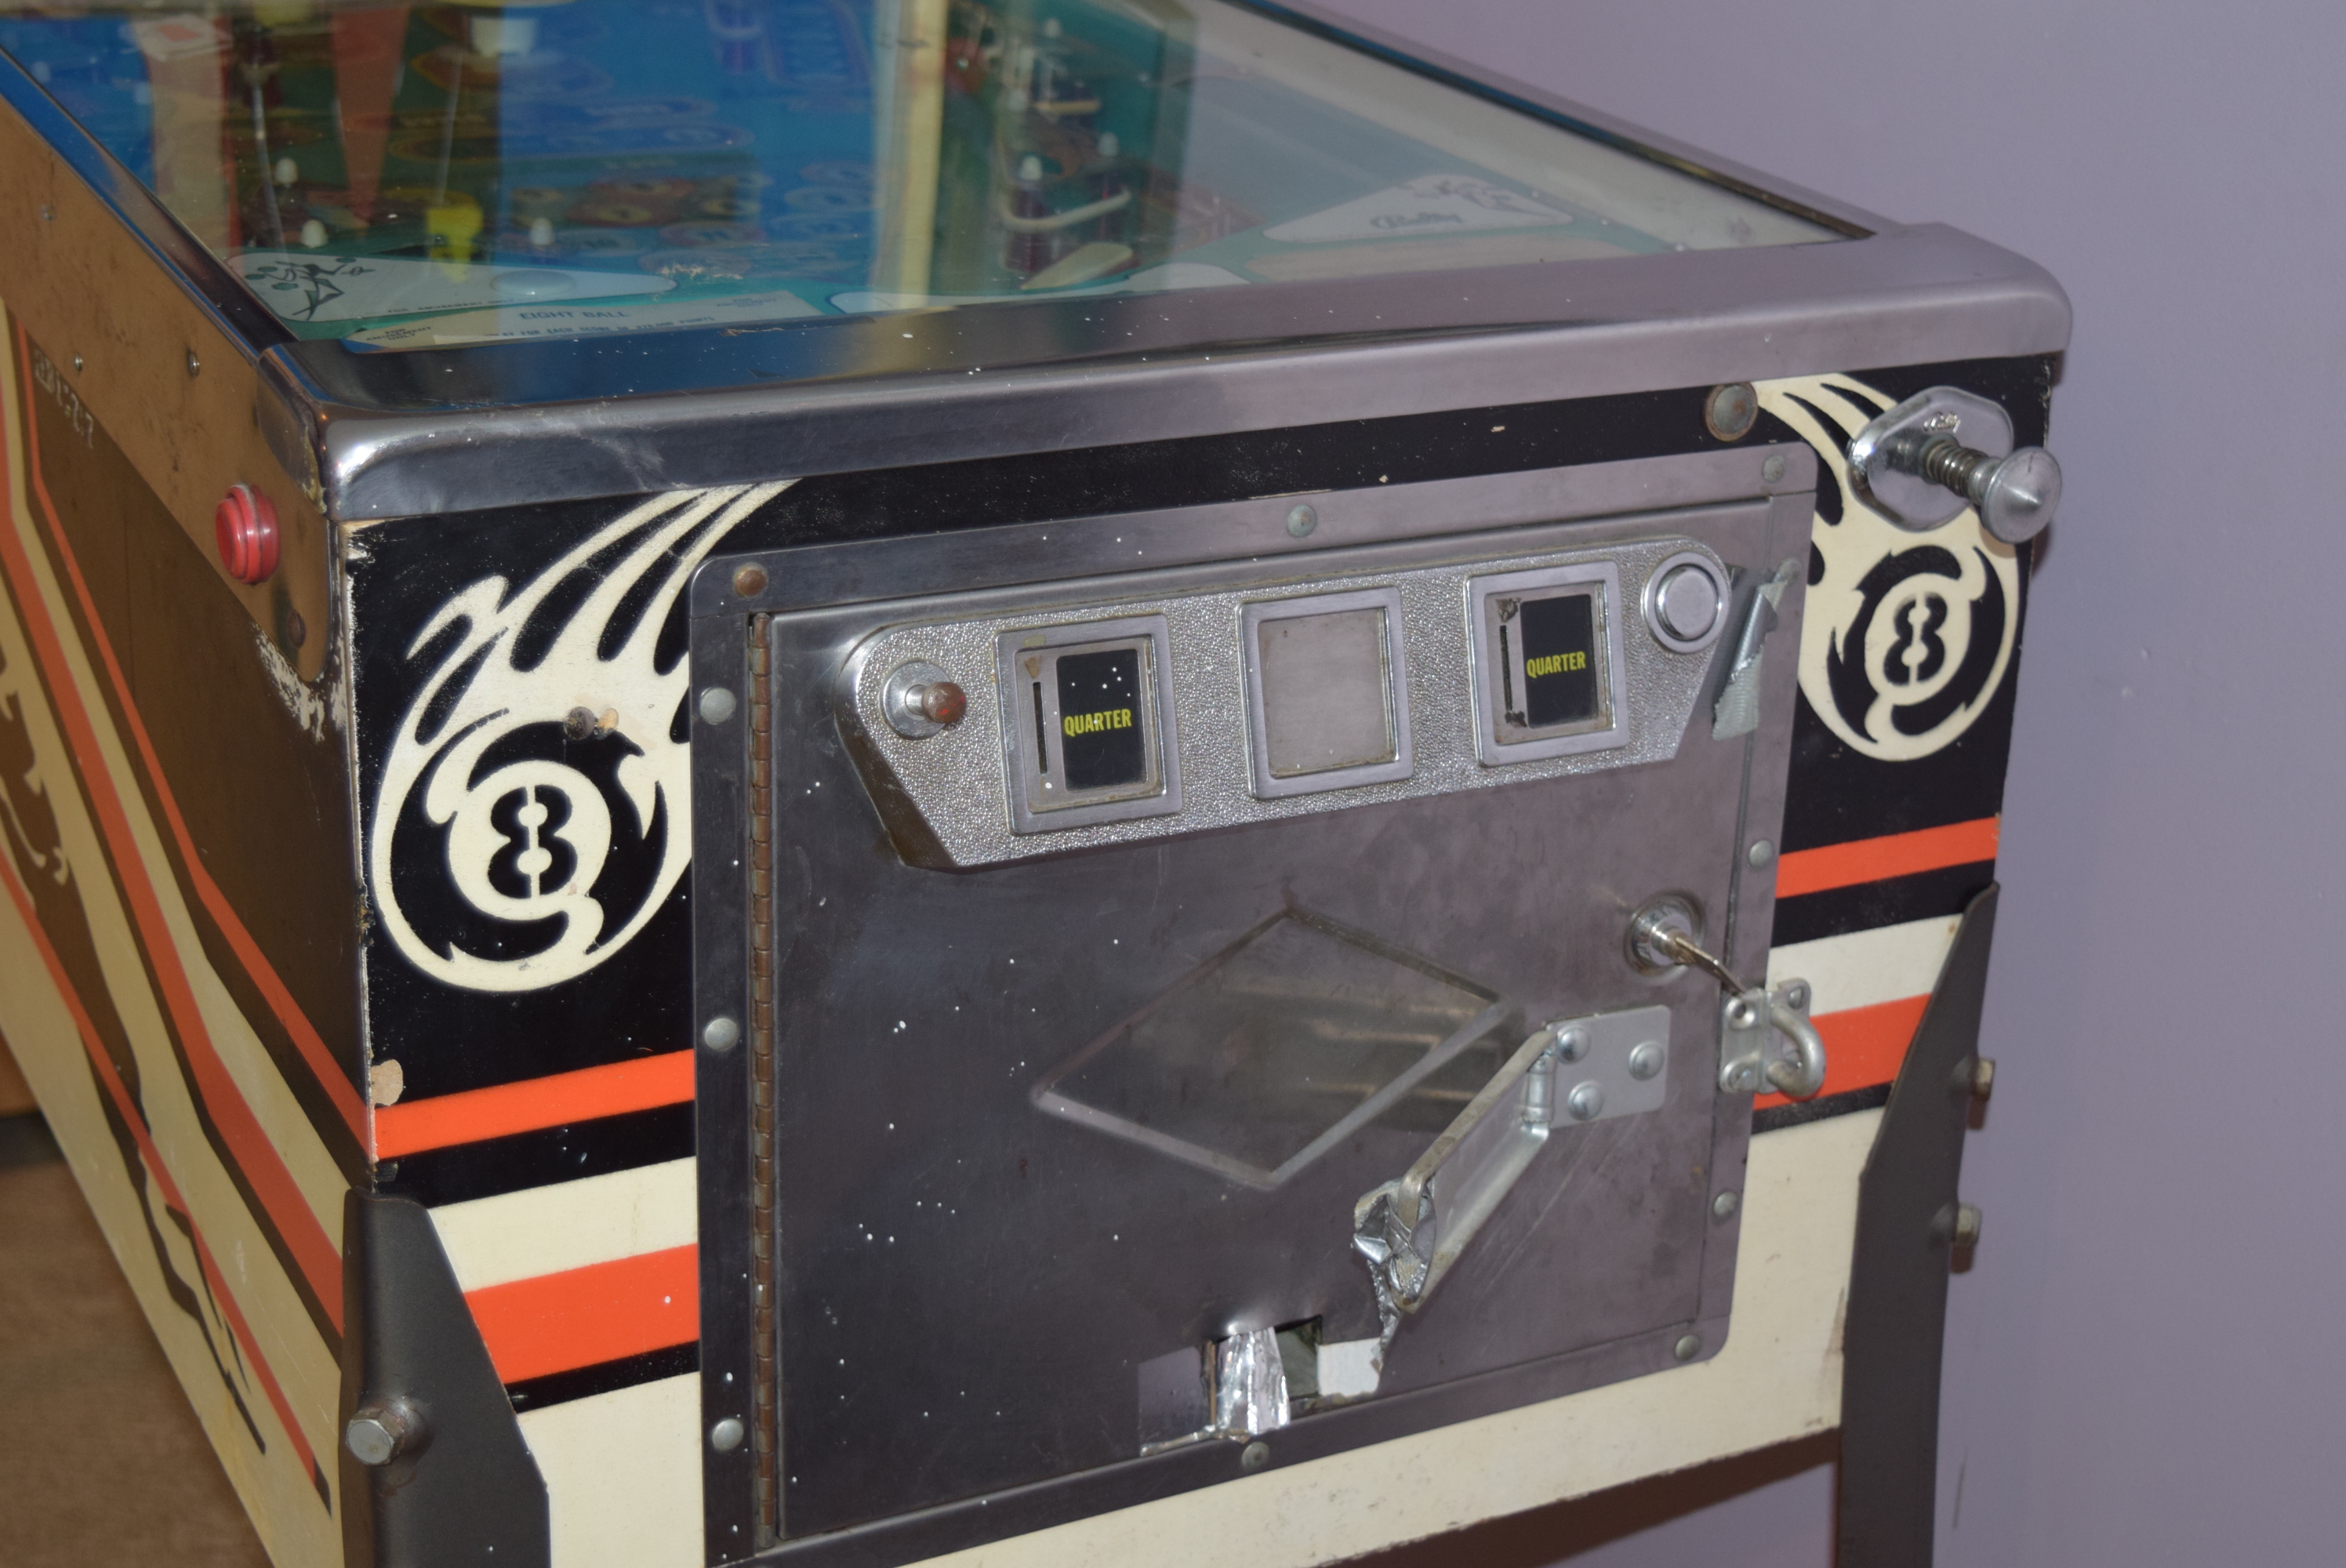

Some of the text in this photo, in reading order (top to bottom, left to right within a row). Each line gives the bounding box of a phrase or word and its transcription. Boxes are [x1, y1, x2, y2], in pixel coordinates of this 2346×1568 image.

[518, 311, 574, 320] EIGHT
[366, 326, 432, 340] AMUSEMENT
[1526, 651, 1586, 679] QUARTER
[1063, 708, 1132, 737] QUARTER
